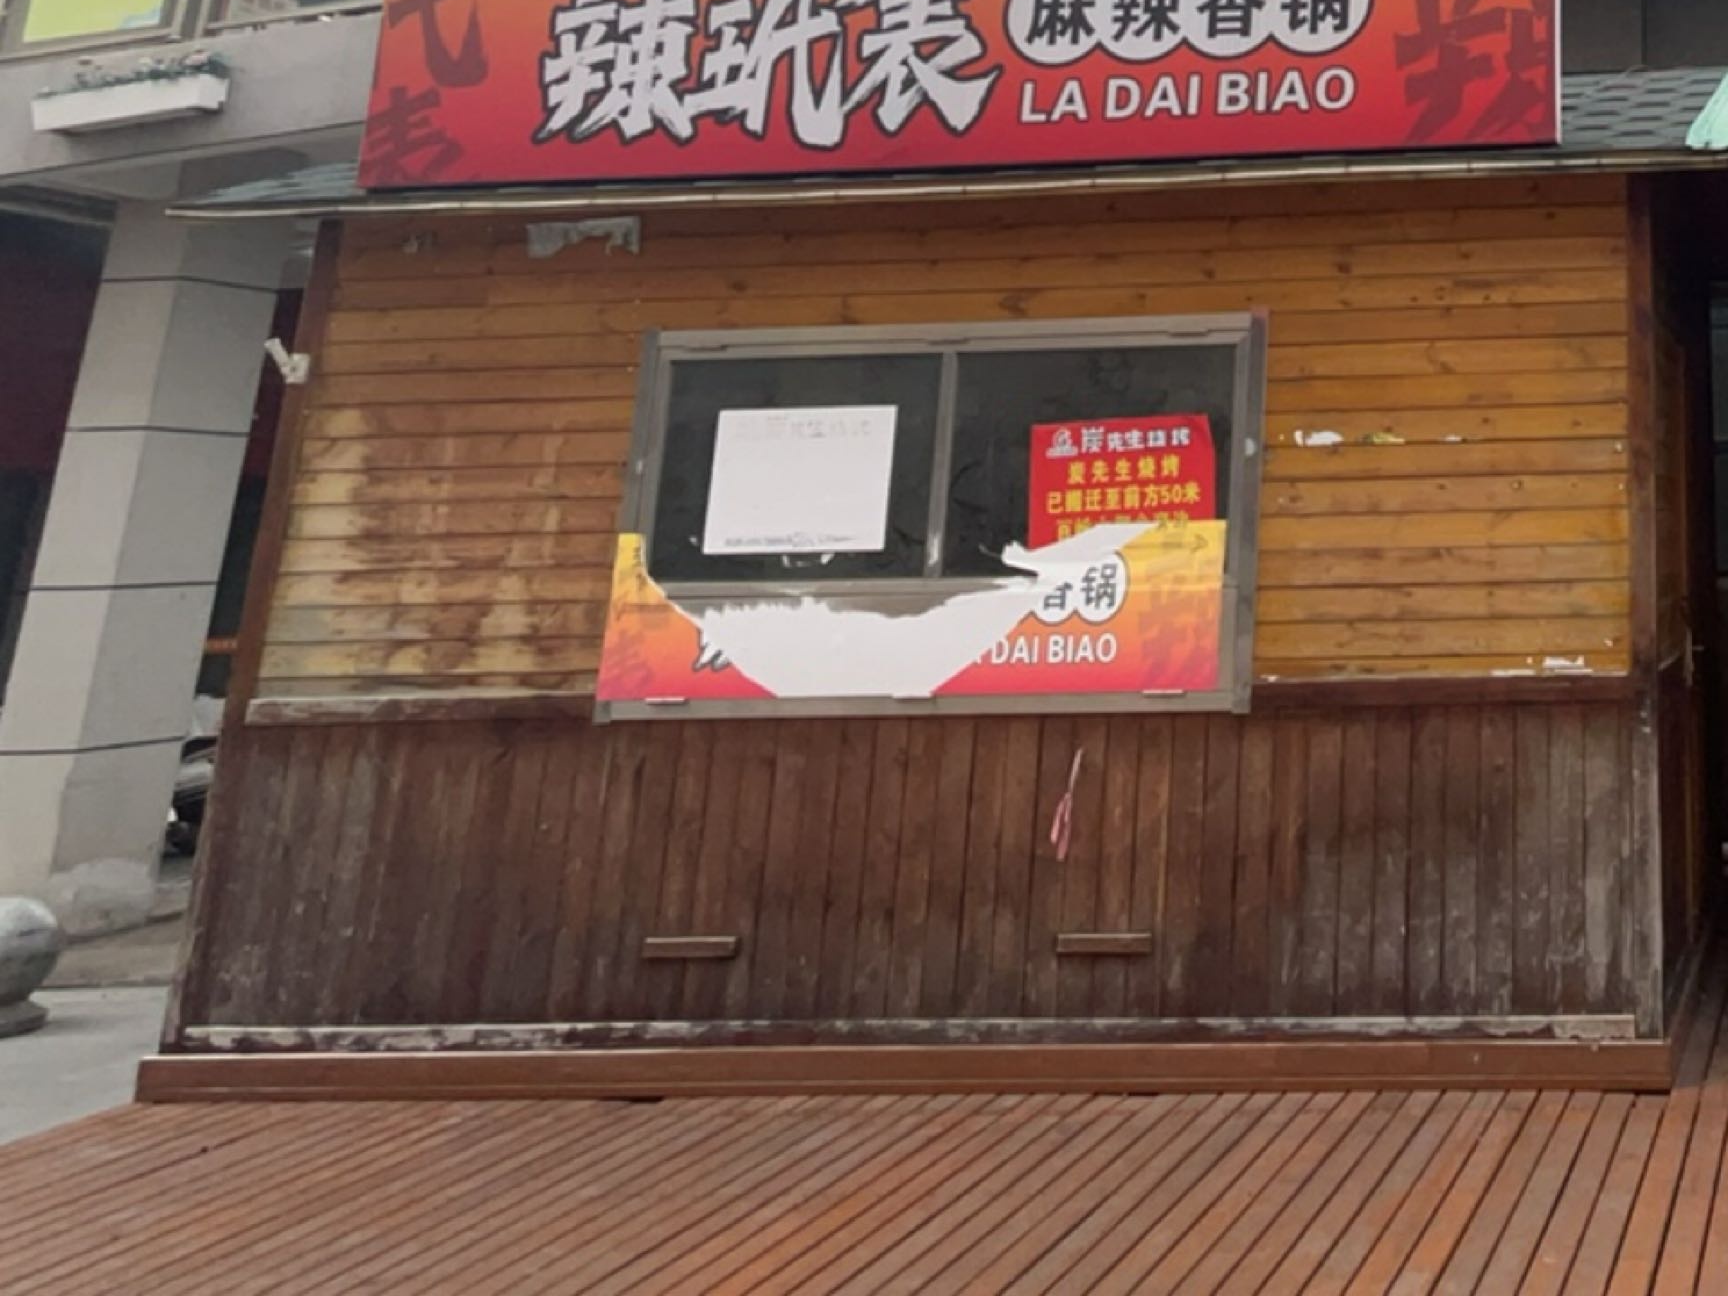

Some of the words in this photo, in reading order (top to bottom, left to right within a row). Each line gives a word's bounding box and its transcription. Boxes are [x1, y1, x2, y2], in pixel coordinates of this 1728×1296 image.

[1018, 76, 1089, 124] LA
[1104, 71, 1201, 120] DAI
[1215, 65, 1357, 116] BIAO
[991, 634, 1040, 665] DAI
[1046, 632, 1119, 664] BIAO
